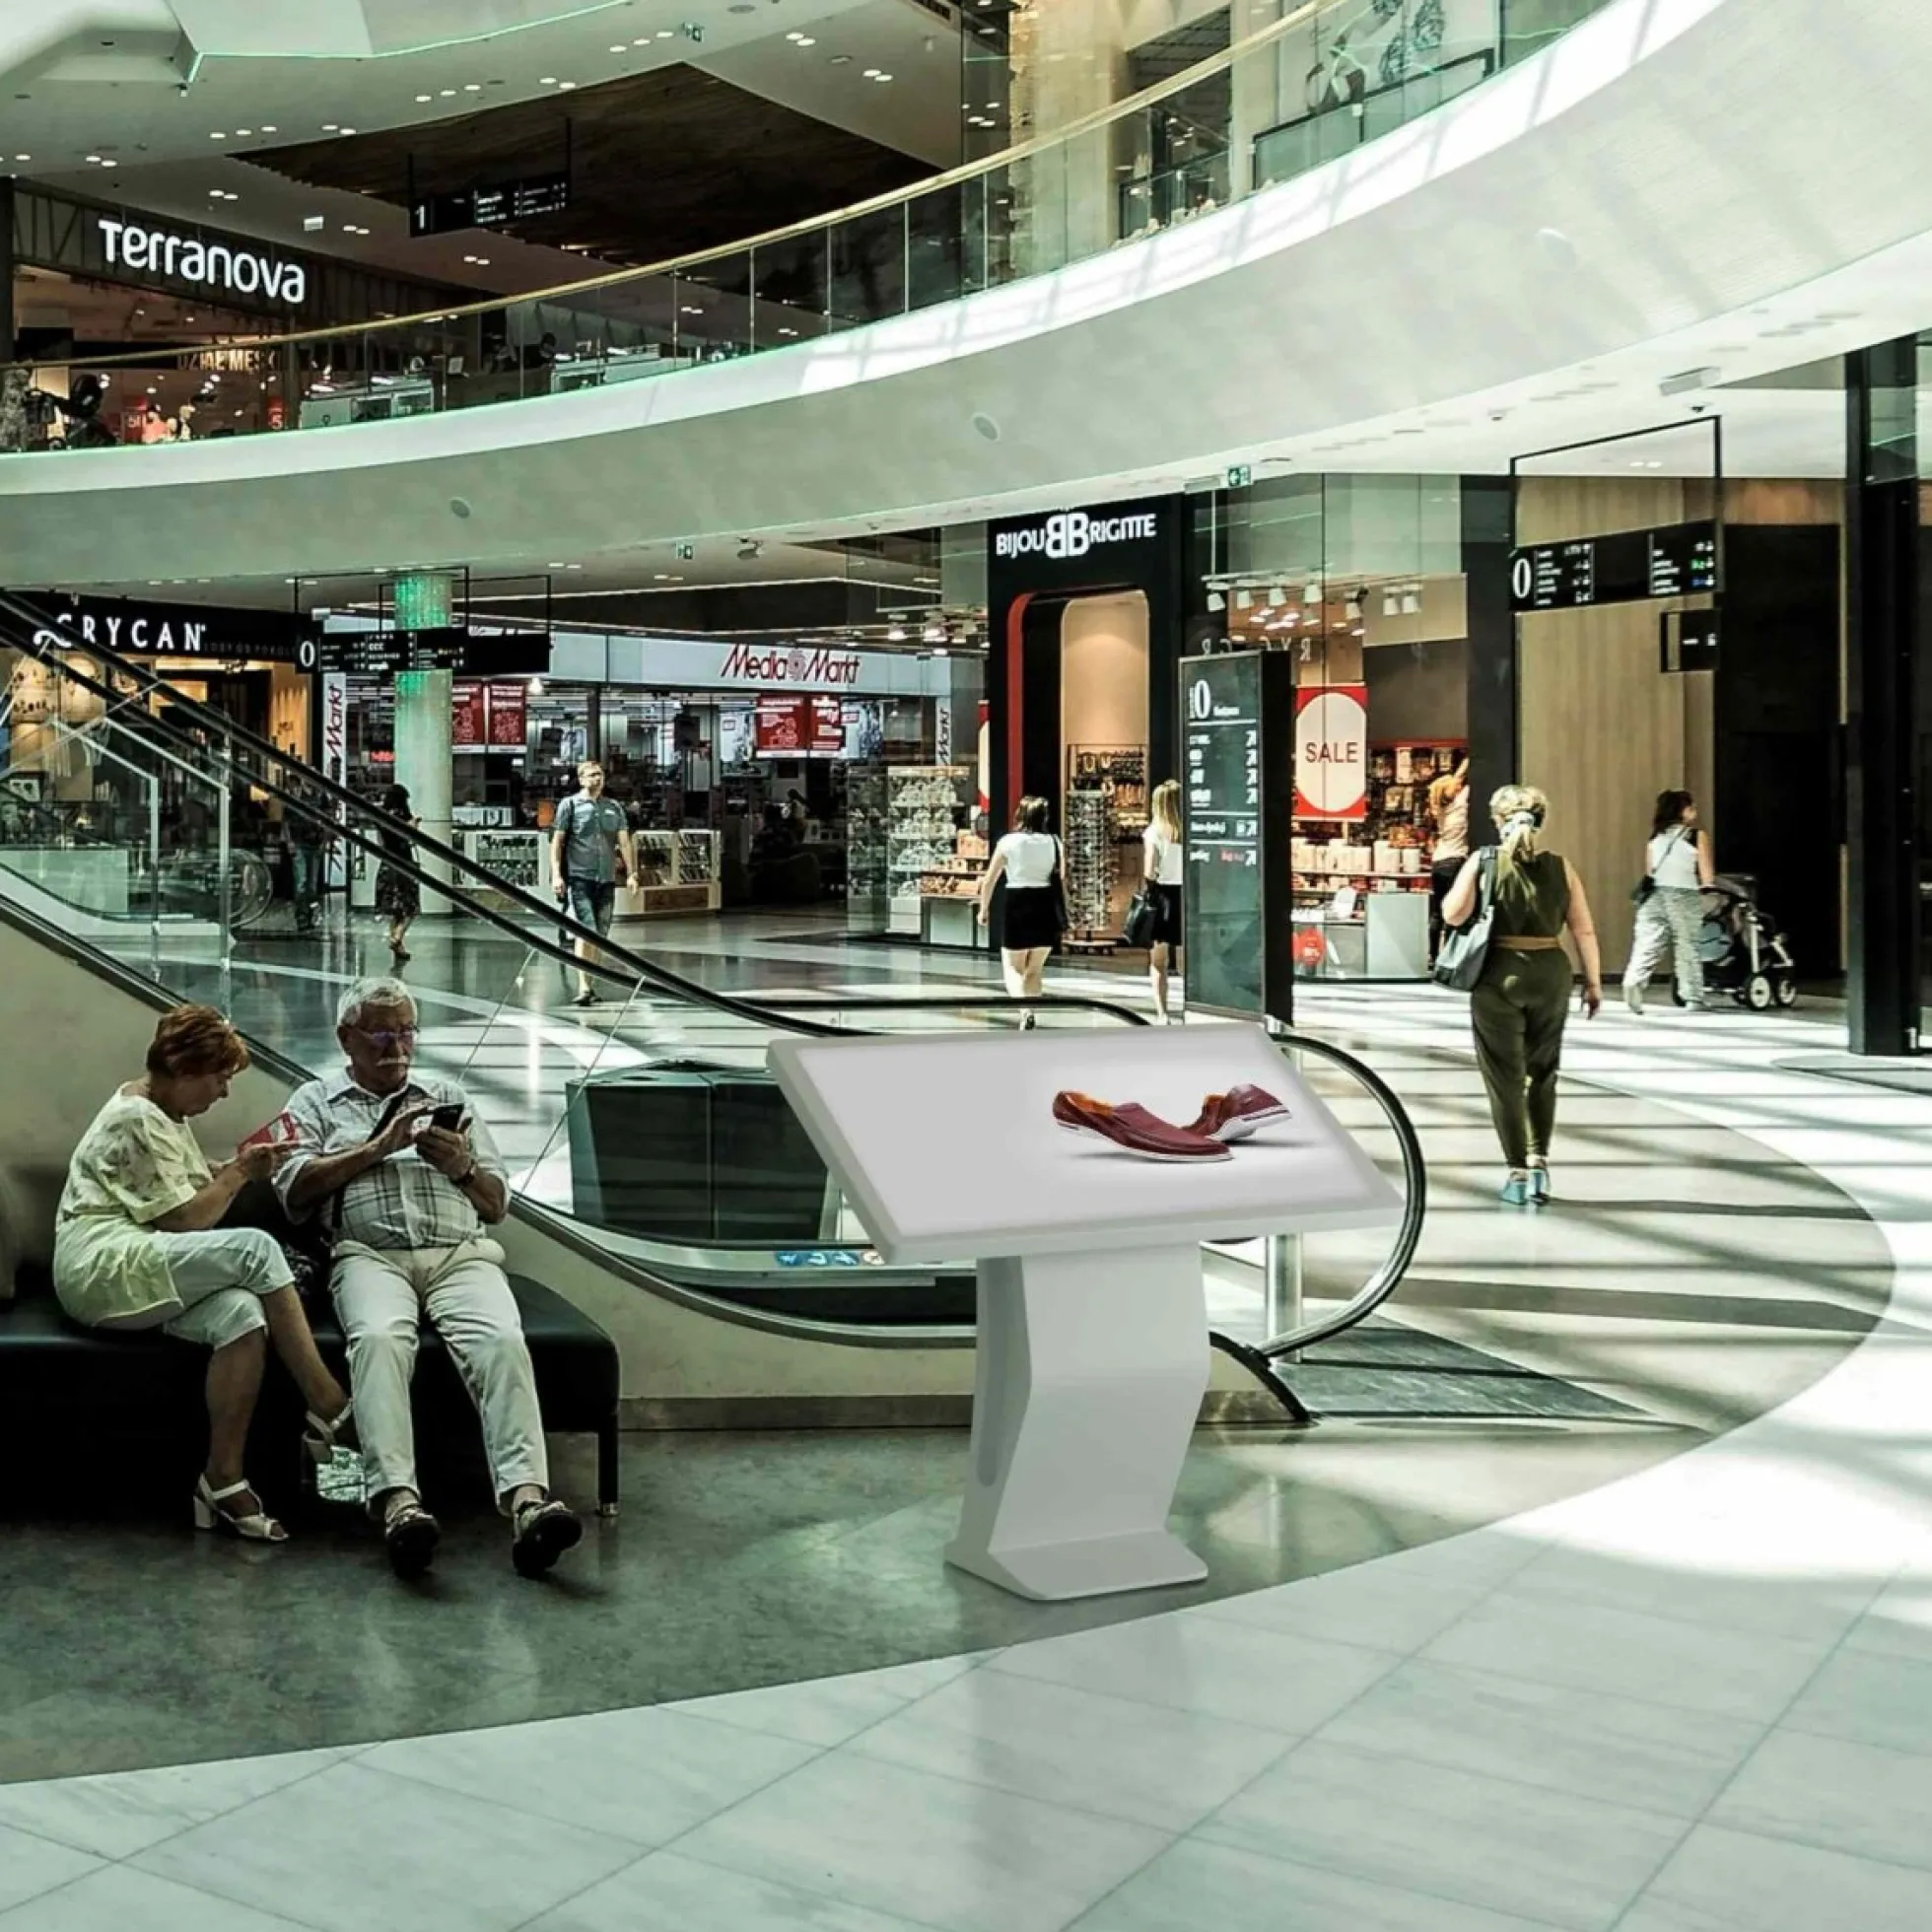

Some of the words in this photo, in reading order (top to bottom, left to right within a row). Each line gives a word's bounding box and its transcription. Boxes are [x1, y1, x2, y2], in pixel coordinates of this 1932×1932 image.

[414, 204, 426, 230] 1
[99, 219, 305, 303] Terranova
[996, 528, 1045, 559] BIJOU
[1513, 558, 1531, 598] 0
[300, 641, 315, 667] 0
[721, 644, 788, 680] Media
[803, 648, 861, 684] Markt
[1194, 679, 1210, 719] 0
[1305, 741, 1358, 764] SALE
